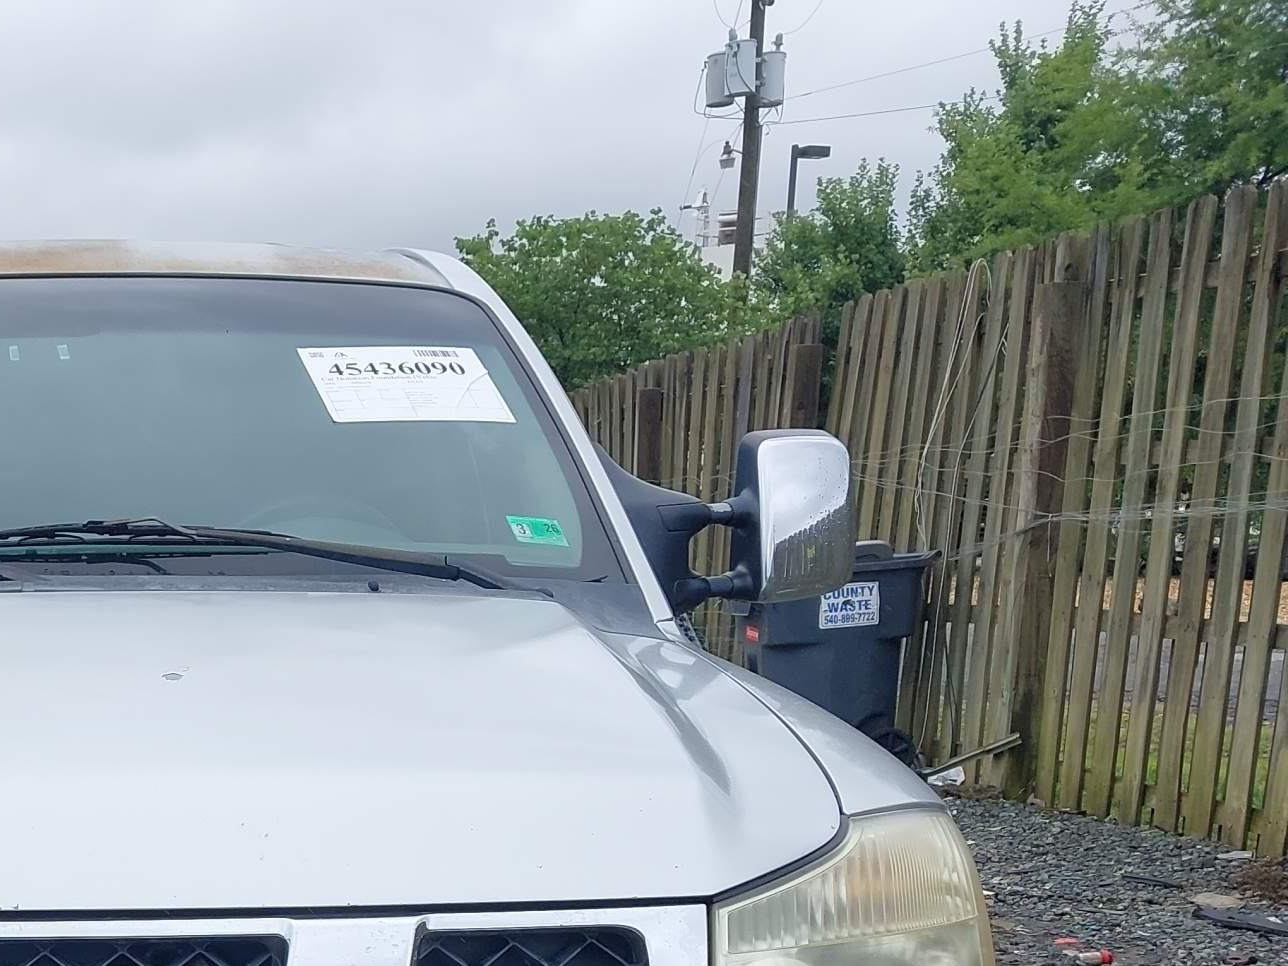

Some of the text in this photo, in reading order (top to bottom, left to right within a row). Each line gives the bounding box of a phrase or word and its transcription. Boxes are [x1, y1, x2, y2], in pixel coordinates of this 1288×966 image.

[328, 361, 466, 376] 45436090
[516, 523, 526, 534] 3
[827, 599, 872, 613] WASTE
